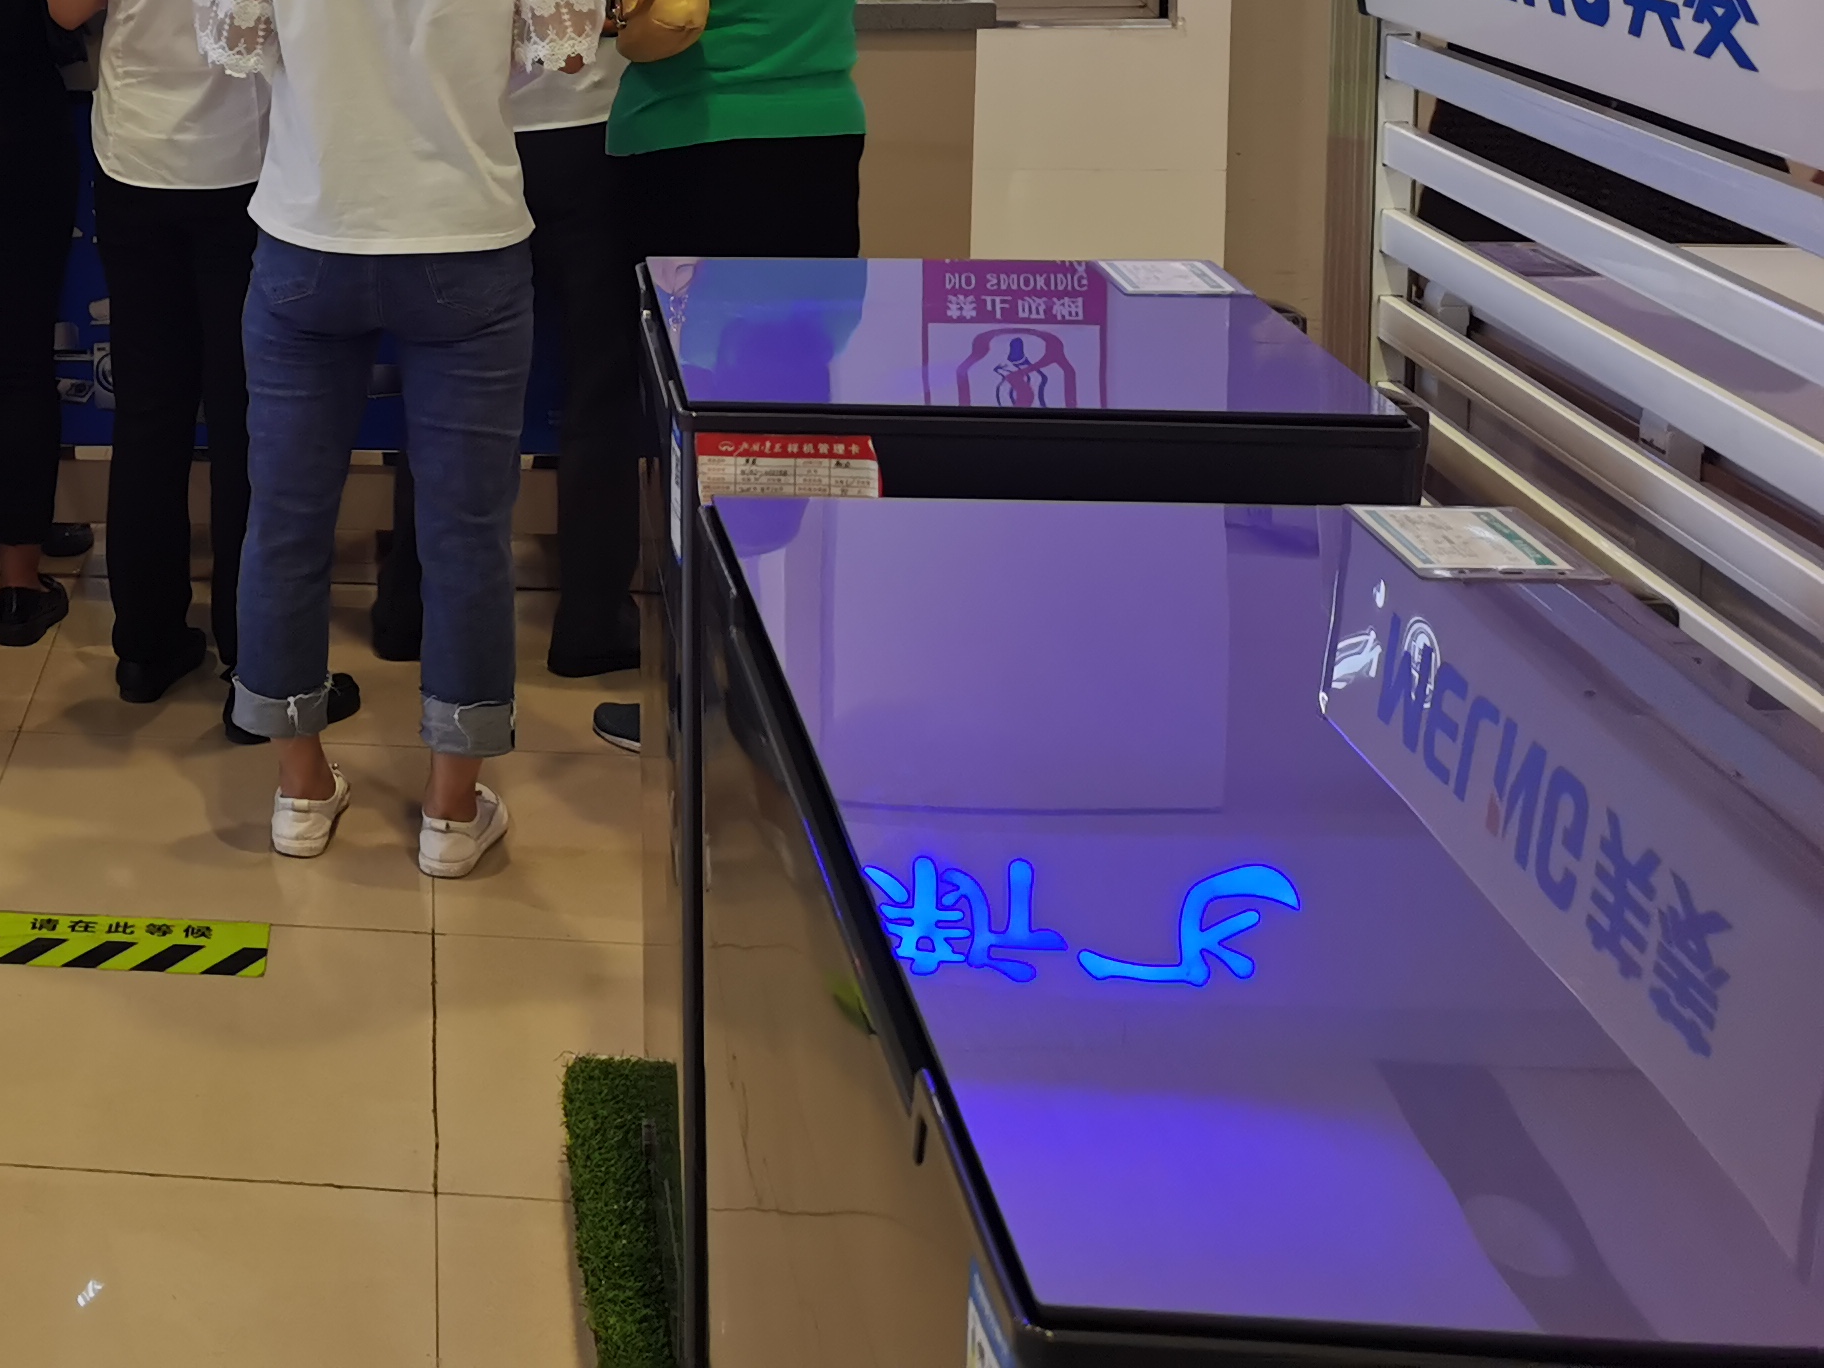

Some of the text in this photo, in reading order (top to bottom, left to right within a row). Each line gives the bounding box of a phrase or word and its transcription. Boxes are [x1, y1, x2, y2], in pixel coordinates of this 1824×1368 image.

[28, 915, 215, 941] 请在此等候
